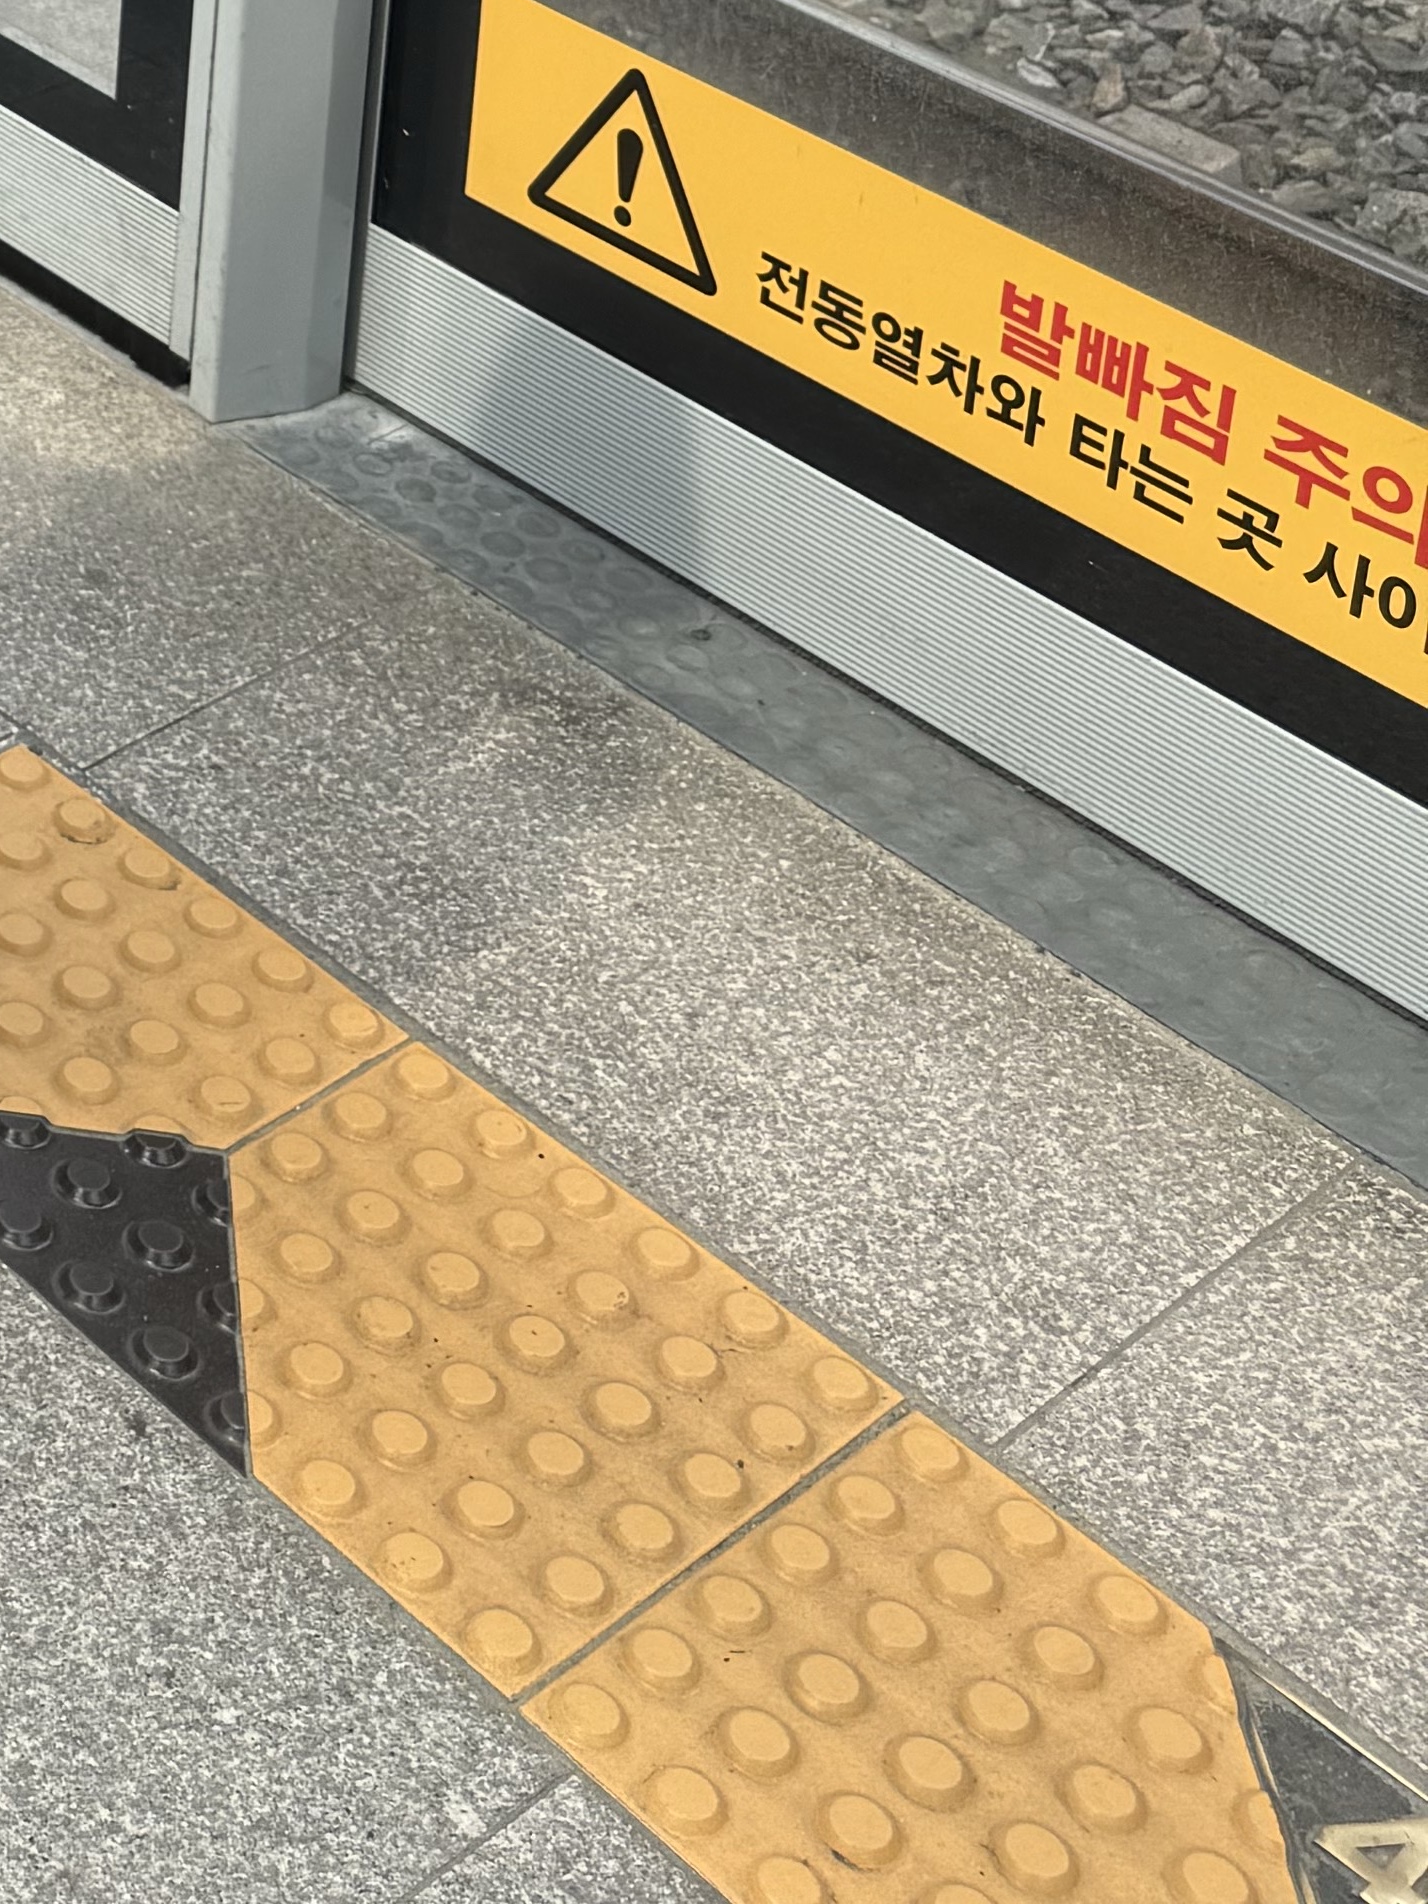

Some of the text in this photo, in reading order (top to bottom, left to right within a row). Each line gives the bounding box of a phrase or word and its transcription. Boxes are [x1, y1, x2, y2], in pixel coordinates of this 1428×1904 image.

[754, 250, 1046, 449] 전동열차와
[1068, 412, 1195, 525] 타는
[1215, 488, 1283, 572] 곳
[999, 279, 1428, 572] 발빠짐 주의
